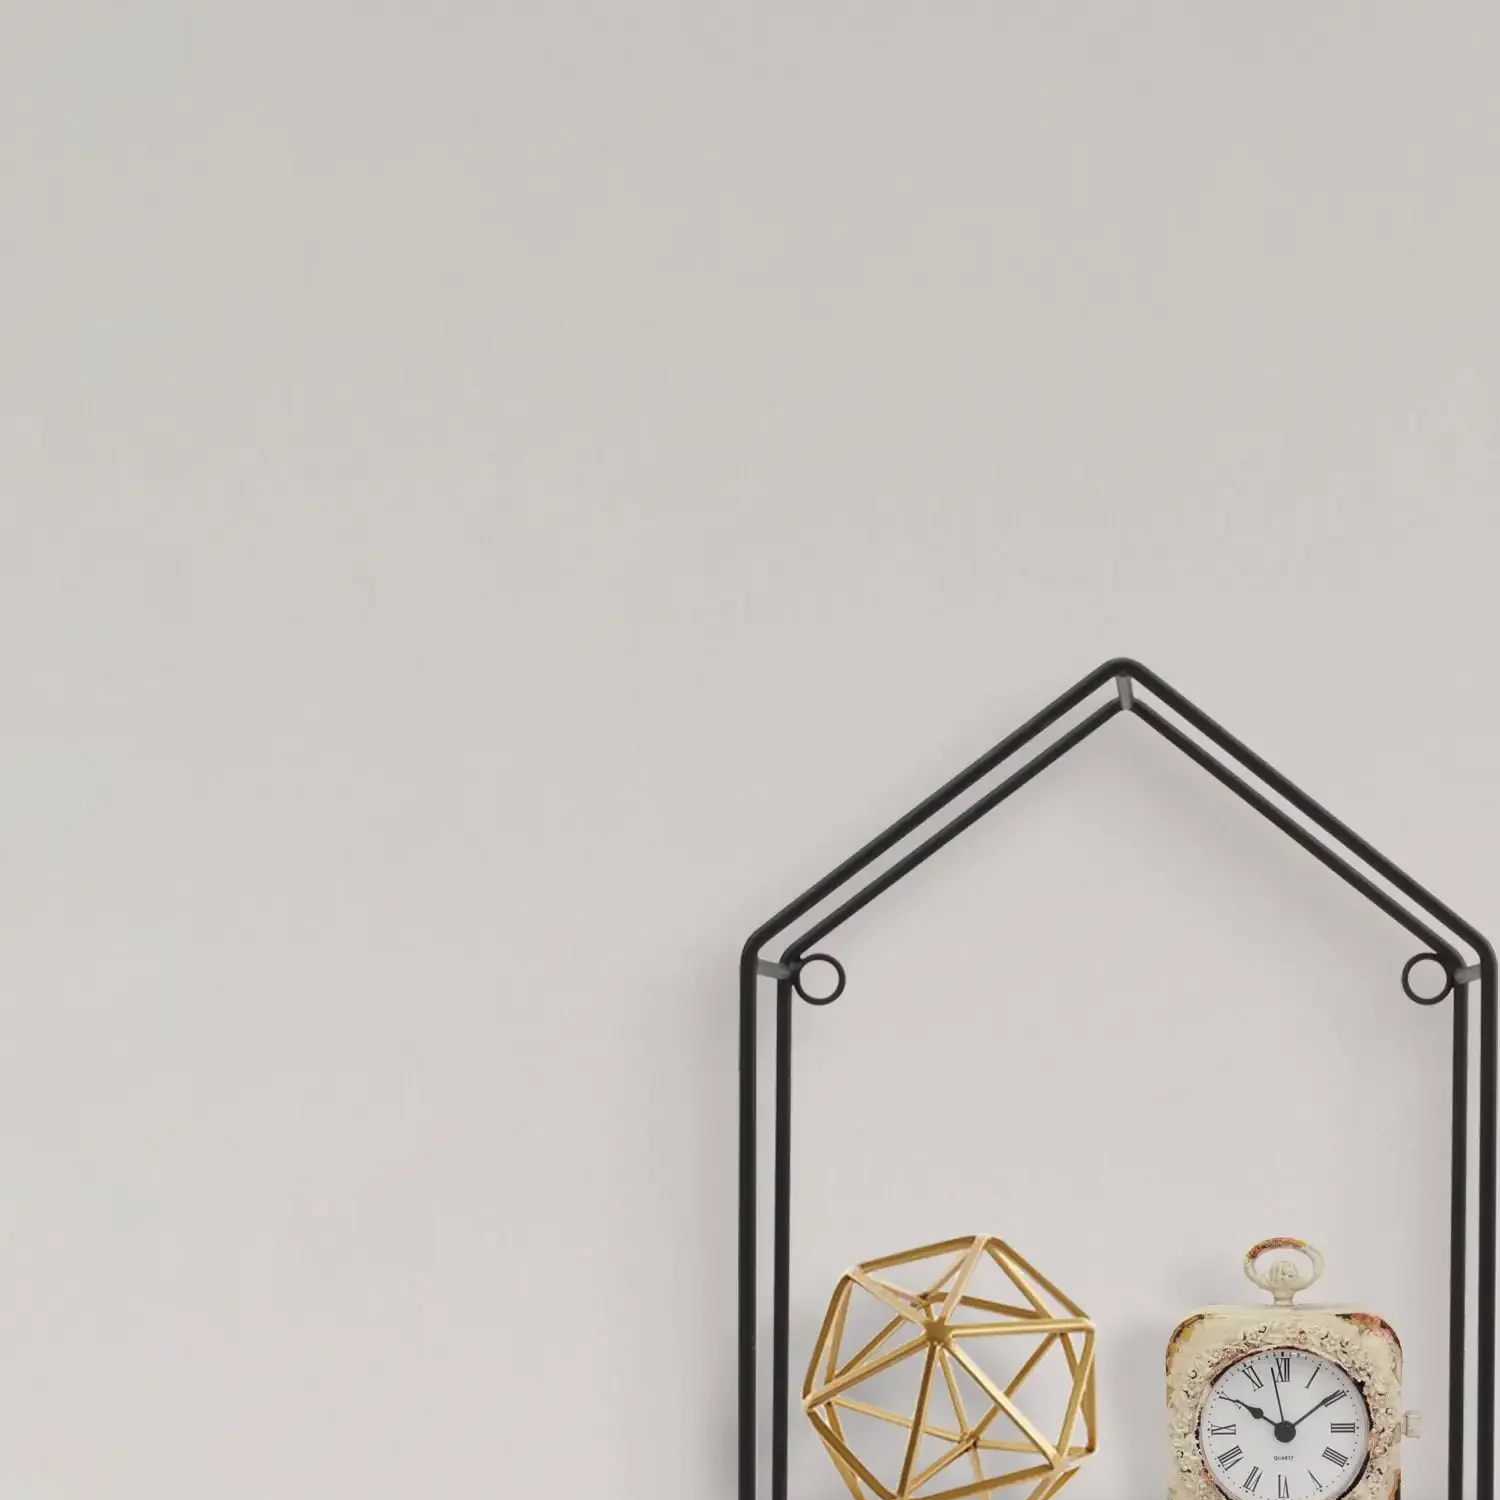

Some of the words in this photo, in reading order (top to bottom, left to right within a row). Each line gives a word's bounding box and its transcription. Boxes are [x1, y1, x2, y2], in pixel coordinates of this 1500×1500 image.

[1242, 1365, 1264, 1391] XI
[1275, 1357, 1291, 1382] XII
[1211, 1424, 1236, 1435] IX
[1330, 1422, 1356, 1433] III
[1217, 1445, 1244, 1471] VIII
[1243, 1466, 1264, 1492] VII
[1277, 1474, 1290, 1498] VI
[1307, 1468, 1323, 1490] V
